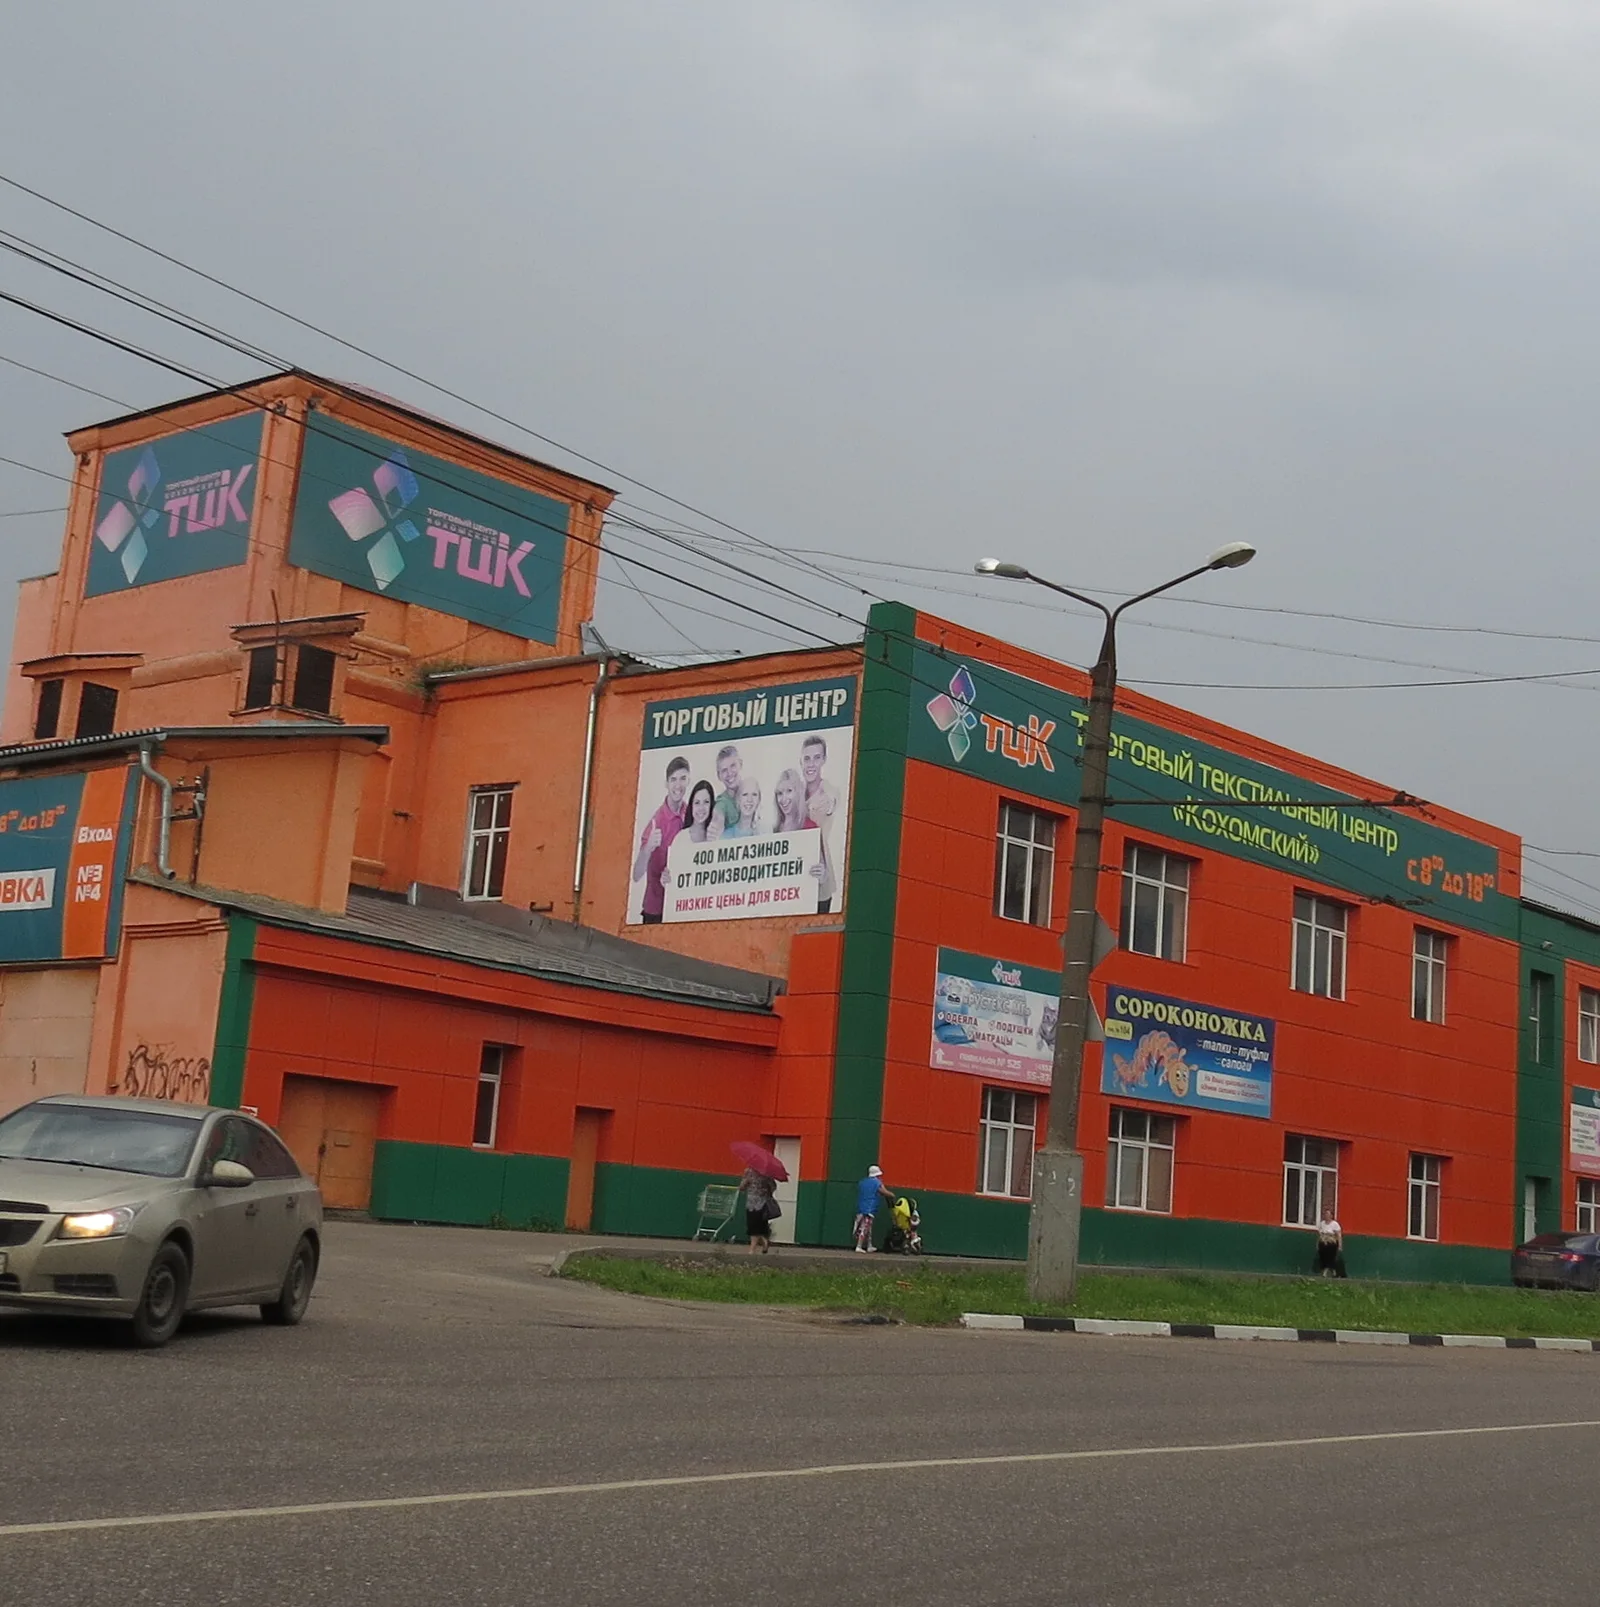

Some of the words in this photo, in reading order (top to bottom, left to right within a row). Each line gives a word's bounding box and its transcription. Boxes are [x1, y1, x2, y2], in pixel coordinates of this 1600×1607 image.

[652, 692, 768, 738] ТОРГОВЫЙ
[774, 688, 848, 728] ЦЕНТР
[77, 826, 114, 844] Вход
[692, 849, 714, 866] 400
[717, 840, 790, 864] МАГАЗИНОВ
[77, 864, 104, 884] №3
[677, 872, 692, 889] ОТ
[694, 857, 804, 887] ПРОИЗВОДИТЕЛЕЙ
[0, 876, 46, 904] ВКА
[75, 884, 102, 903] №4
[675, 895, 713, 913] НИЗКИЕ
[715, 893, 746, 910] ЦЕНЫ
[747, 889, 771, 907] ДЛЯ
[773, 886, 801, 902] ВСЕХ
[946, 1012, 979, 1027] ОДЕЯЛА
[996, 1021, 1034, 1036] ПОДУШКИ
[1114, 994, 1267, 1043] СОРОКОНОЖКА
[973, 1030, 1014, 1046] МАТРАЦЫ
